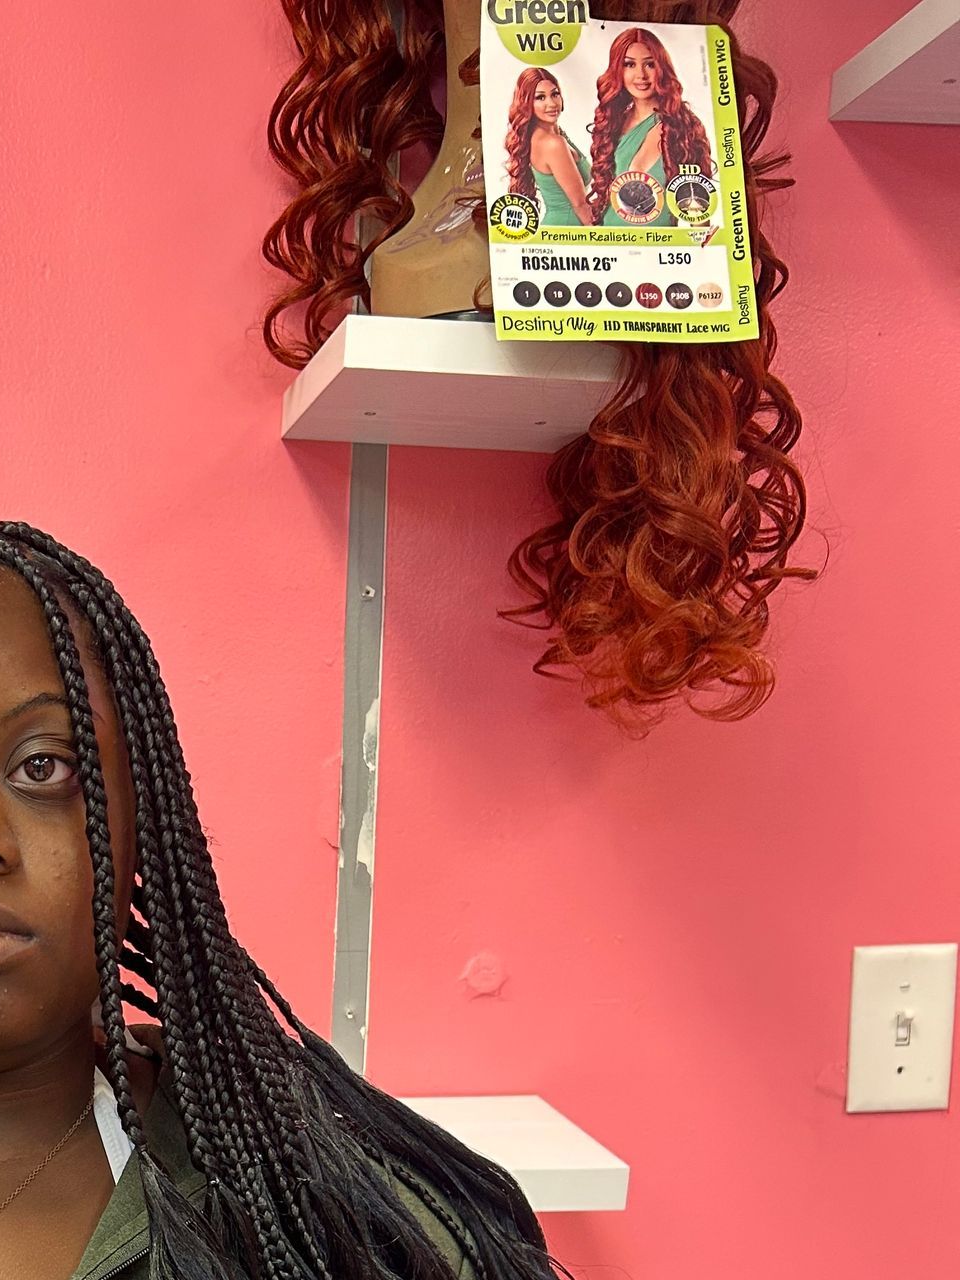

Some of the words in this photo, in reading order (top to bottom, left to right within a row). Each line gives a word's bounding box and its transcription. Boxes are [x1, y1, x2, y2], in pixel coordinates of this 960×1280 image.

[487, 0, 587, 24] Green
[516, 33, 563, 51] WIG
[715, 38, 726, 63] WIG
[718, 65, 731, 106] Green
[723, 127, 735, 168] Destiny
[679, 164, 701, 175] HD
[730, 190, 741, 216] WIG
[491, 199, 505, 222] Anti
[504, 195, 537, 232] Bacterial
[506, 209, 523, 220] WIG
[506, 218, 523, 229] CAP
[541, 231, 587, 241] Premium
[589, 232, 637, 242] Realistic
[646, 231, 673, 242] Fiber
[732, 219, 746, 262] Green
[521, 256, 590, 271] ROSALINA
[593, 257, 618, 271] 26"
[658, 252, 691, 264] L350
[524, 290, 530, 298] 1
[552, 290, 564, 298] 1B
[586, 291, 593, 299] 2
[640, 291, 658, 300] L350
[738, 285, 750, 326] Destiny
[502, 316, 565, 335] Destiny
[566, 316, 598, 336] Wig
[603, 320, 621, 331] HD
[623, 321, 683, 333] TRANSPARENT
[686, 323, 709, 333] Lace
[711, 324, 730, 333] WIG
